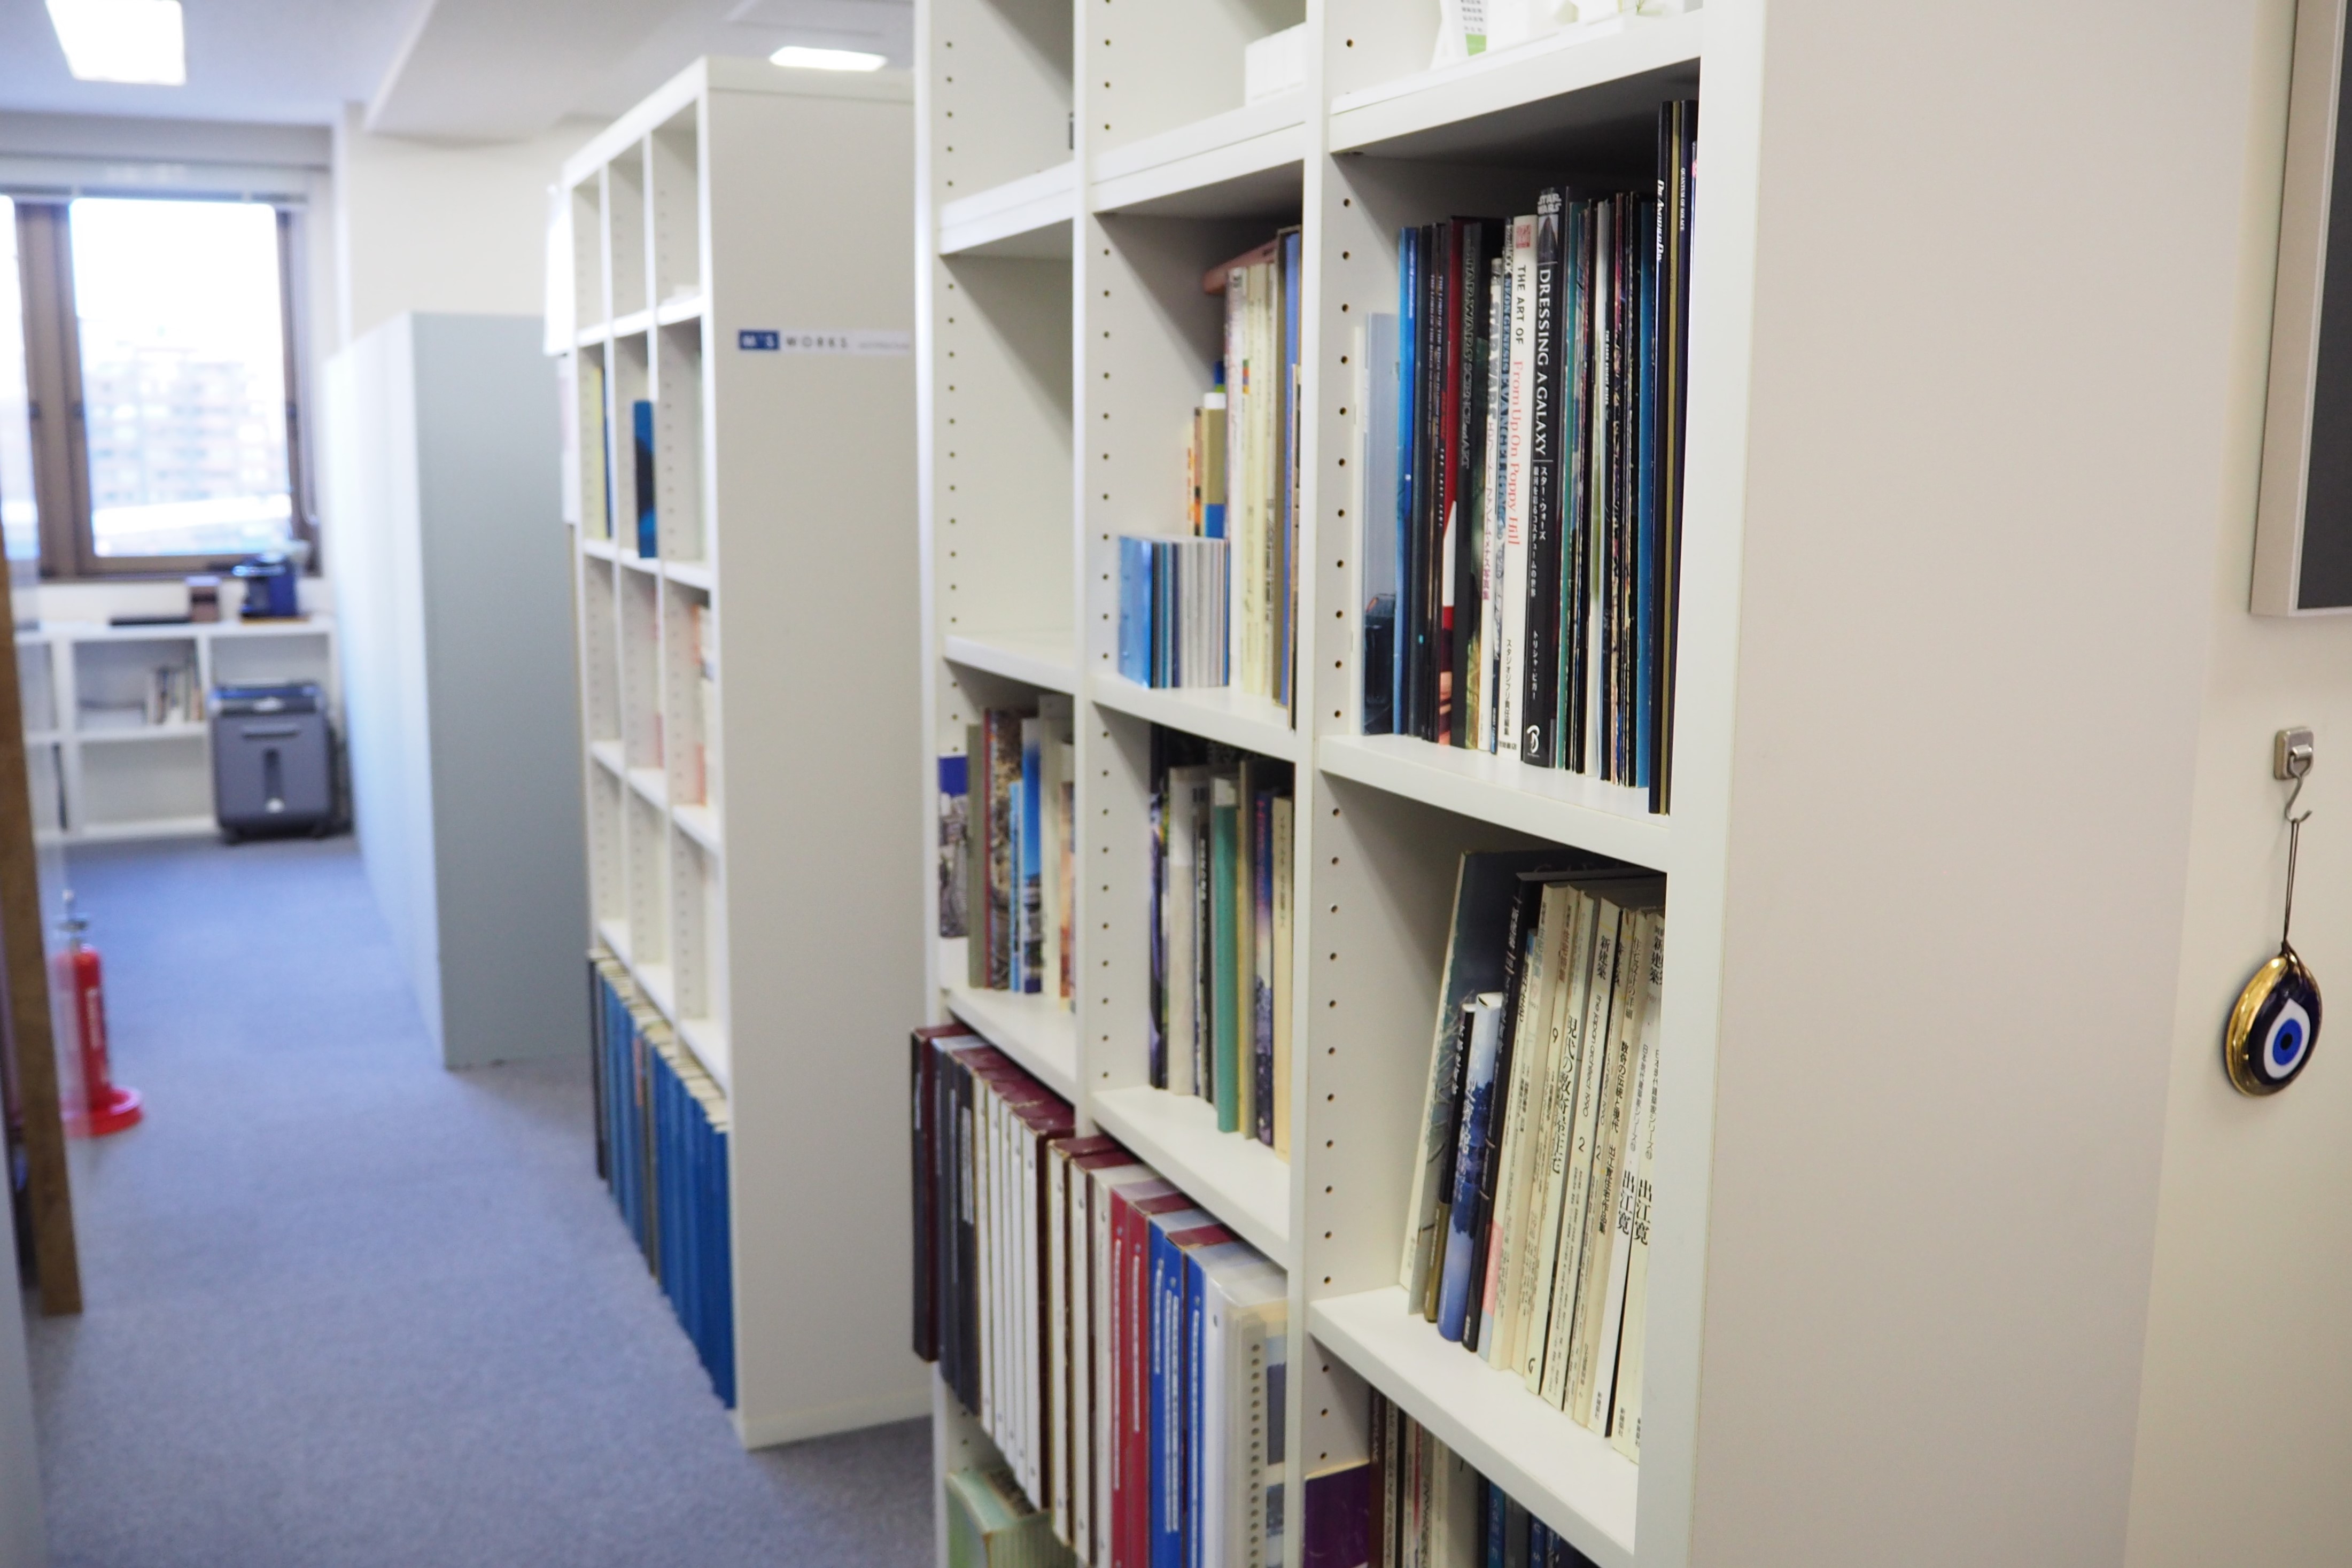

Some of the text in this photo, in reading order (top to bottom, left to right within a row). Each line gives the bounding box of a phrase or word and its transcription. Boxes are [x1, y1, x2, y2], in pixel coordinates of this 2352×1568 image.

[1538, 193, 1562, 205] STAR
[1538, 203, 1562, 215] WARS
[1504, 278, 1512, 313] NEON
[1502, 315, 1510, 372] GENESIS
[1533, 269, 1551, 455] DRESSING A GALAXY
[1508, 264, 1526, 545] THE ART OF From Up On Poppy Hill
[1597, 934, 1611, 981] 新建築
[1552, 1027, 1559, 1043] 9
[1590, 1012, 1600, 1044] japan
[1586, 1045, 1597, 1090] architect
[1578, 1136, 1585, 1153] 2
[1595, 1145, 1602, 1160] 2
[1616, 1169, 1635, 1236] 出江寛
[1633, 1179, 1652, 1246] 出江寛
